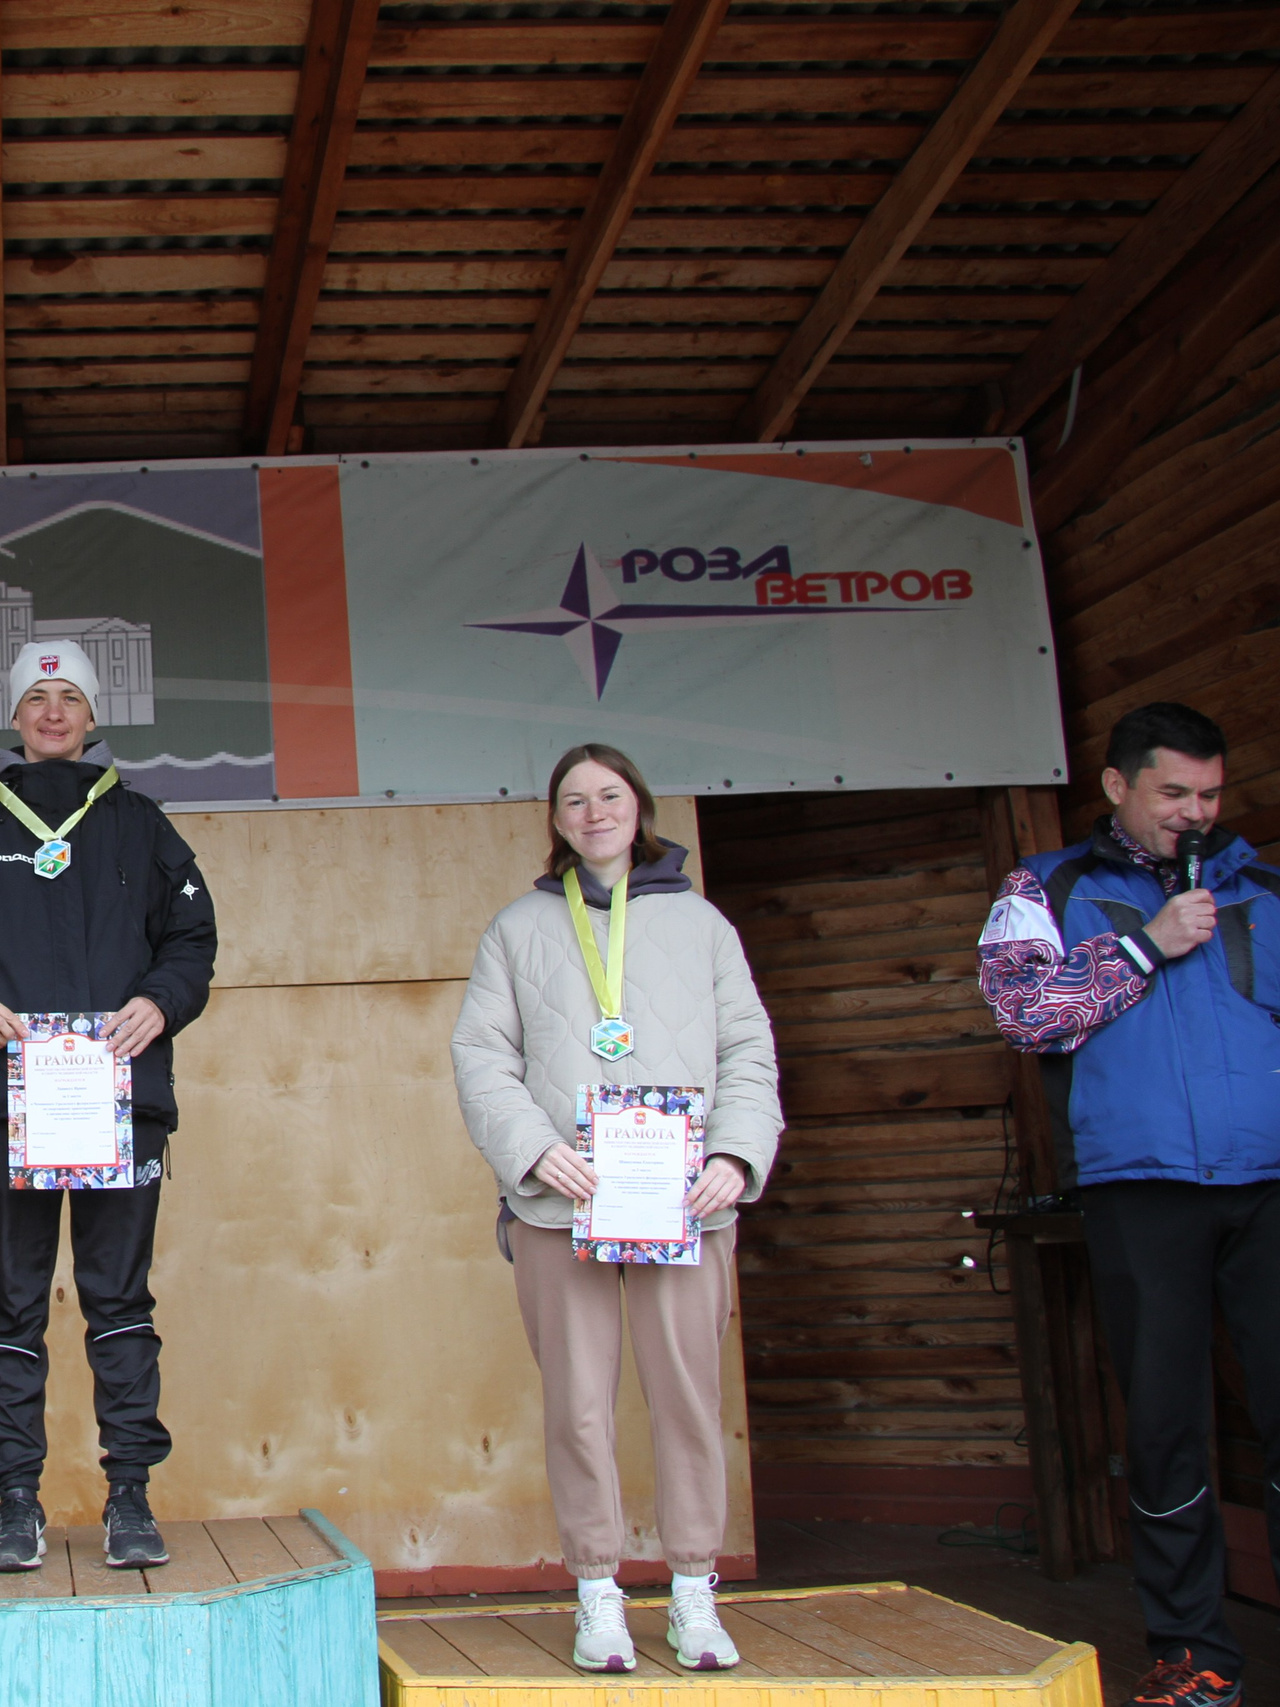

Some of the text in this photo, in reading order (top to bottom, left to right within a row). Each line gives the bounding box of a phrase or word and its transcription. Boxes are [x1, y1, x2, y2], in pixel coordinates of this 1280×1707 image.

[621, 545, 792, 583] РОЗА
[755, 569, 973, 605] ВЕТРОВ
[34, 1054, 104, 1066] ГРАМОТА
[604, 1127, 676, 1140] ГРАМОТА
